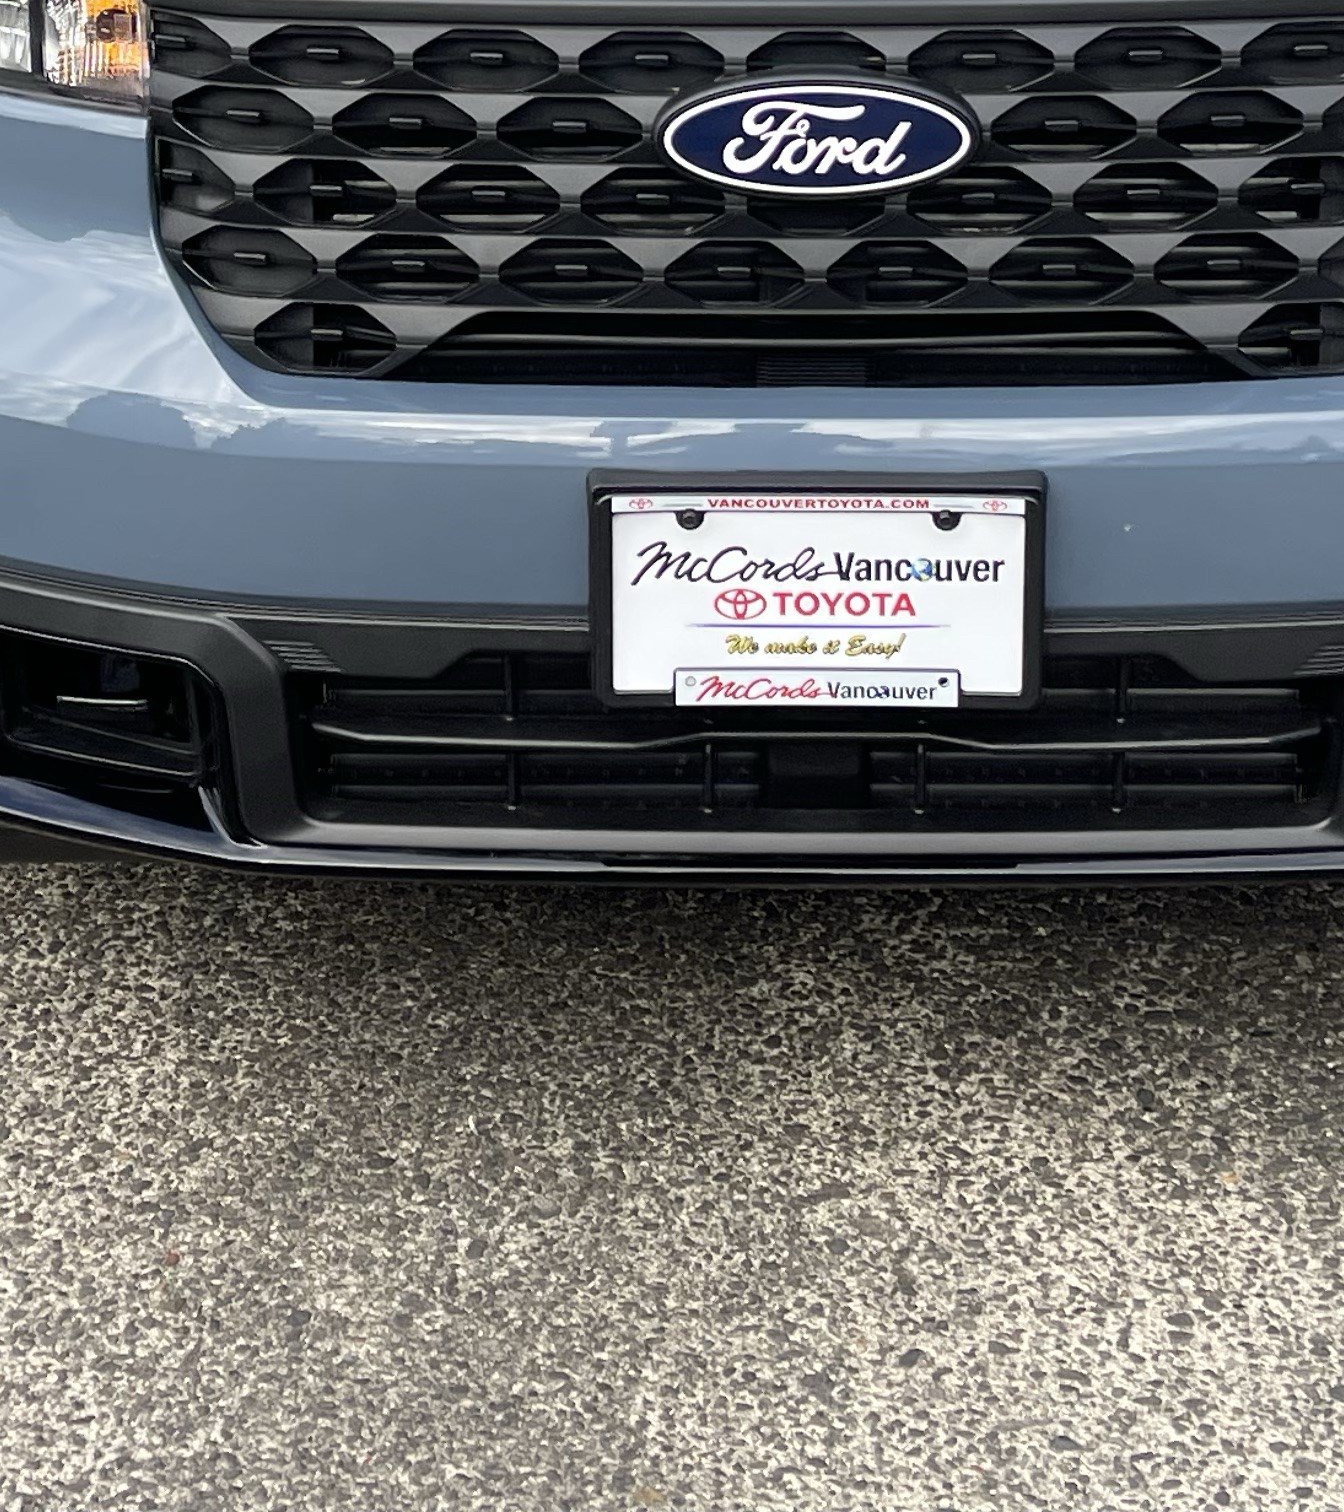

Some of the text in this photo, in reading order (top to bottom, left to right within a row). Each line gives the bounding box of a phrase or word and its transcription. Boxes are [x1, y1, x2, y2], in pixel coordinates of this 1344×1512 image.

[721, 99, 913, 175] Ford
[707, 498, 930, 509] VANCOUVERTOYOTA.COM
[833, 551, 1006, 582] Vancouver
[772, 591, 917, 617] TOYOTA
[725, 634, 759, 655] We
[764, 635, 817, 655] make
[844, 632, 907, 659] Easy!
[826, 681, 938, 701] Vancouver
